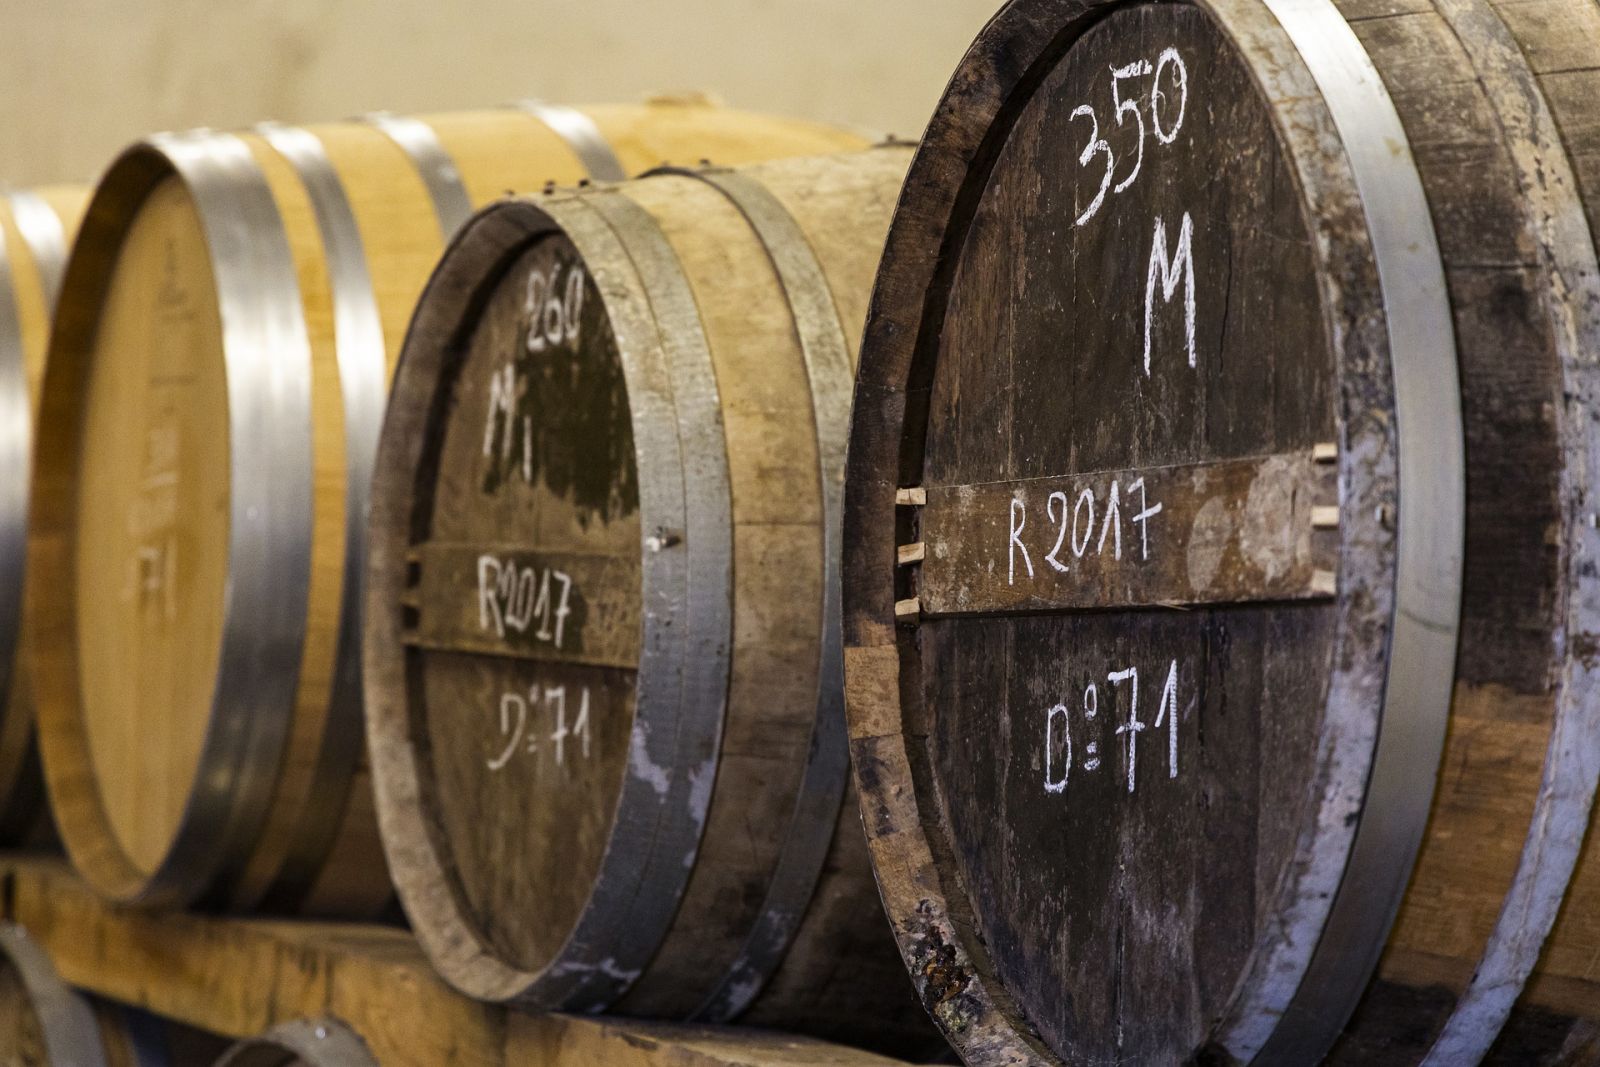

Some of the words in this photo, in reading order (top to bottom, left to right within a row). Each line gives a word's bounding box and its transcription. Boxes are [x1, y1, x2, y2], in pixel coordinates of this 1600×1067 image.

[1068, 47, 1188, 226] 350
[526, 263, 585, 350] 260
[1144, 211, 1196, 377] M
